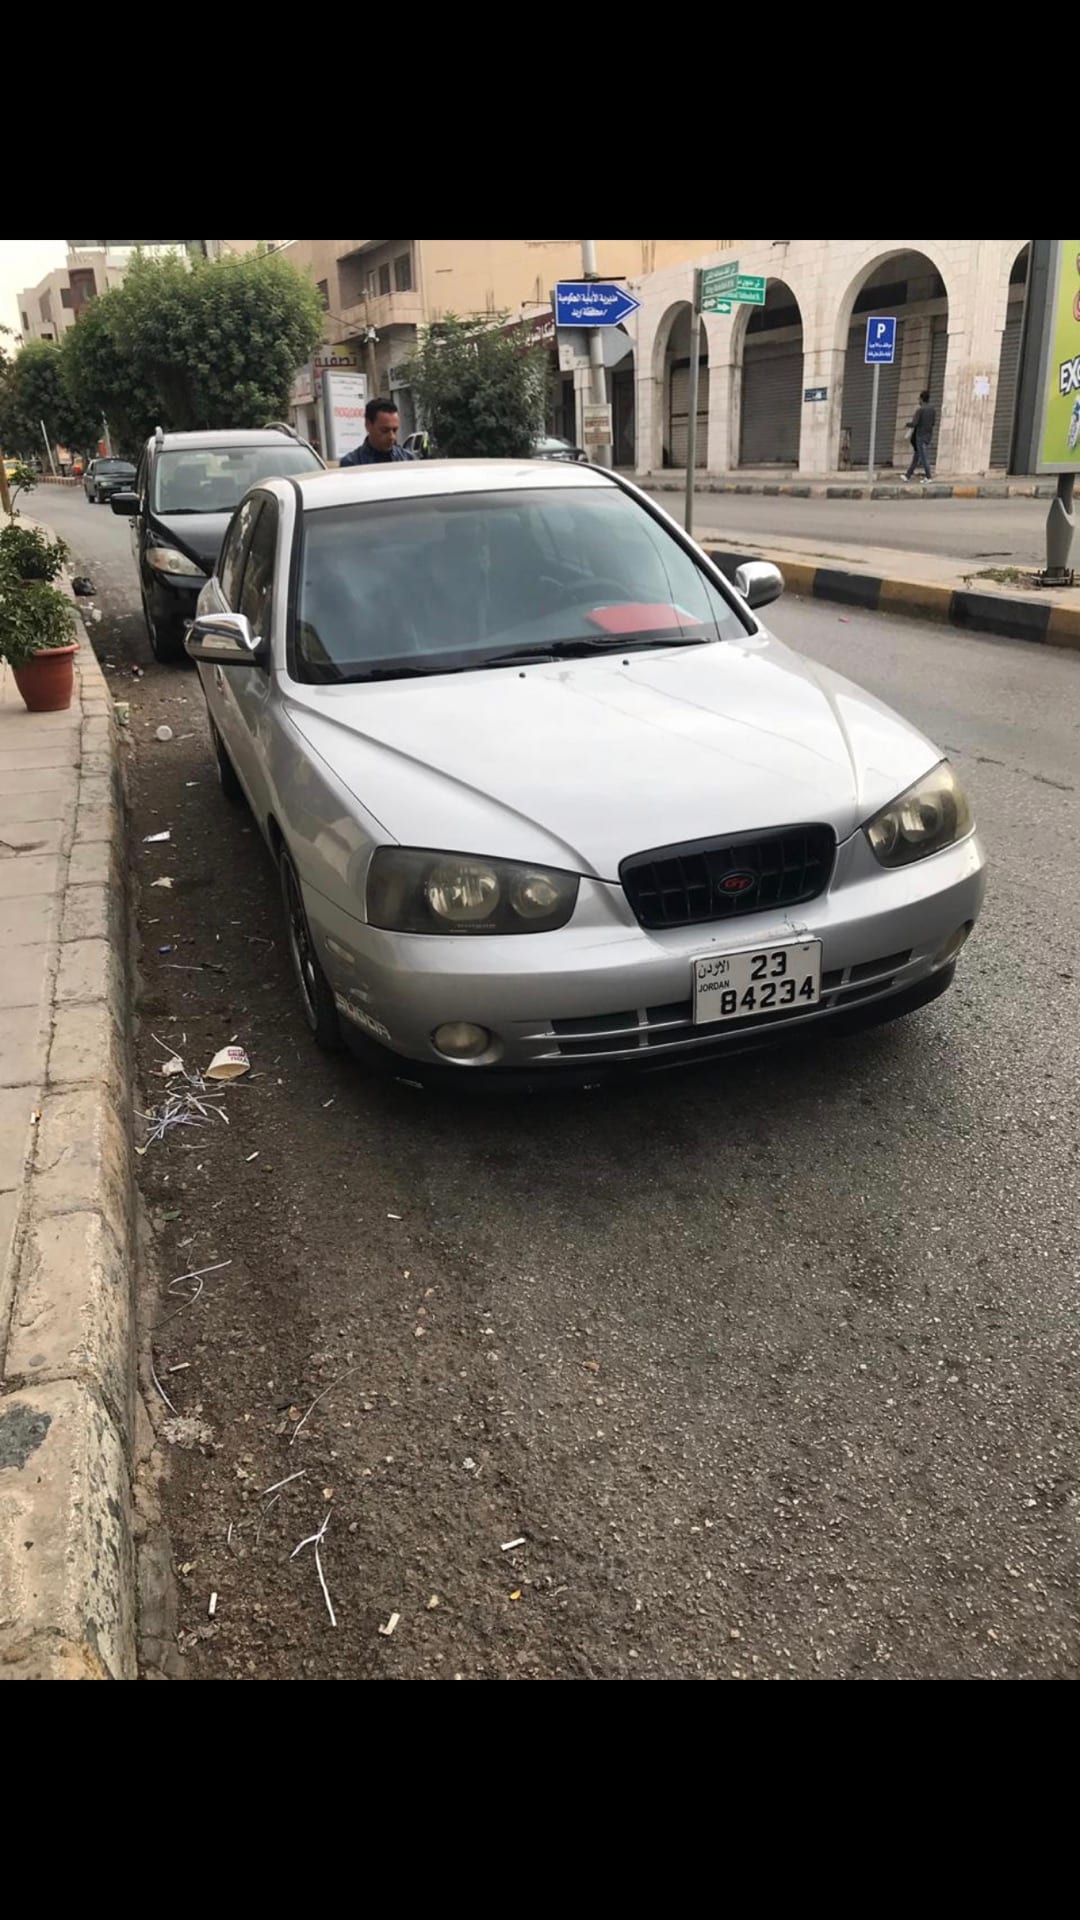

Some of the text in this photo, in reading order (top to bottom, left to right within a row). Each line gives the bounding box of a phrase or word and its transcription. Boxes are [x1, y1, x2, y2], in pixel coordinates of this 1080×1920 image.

[876, 323, 887, 339] P
[751, 951, 787, 981] 23
[698, 979, 730, 993] JORDAN
[720, 975, 815, 1015] 84234
